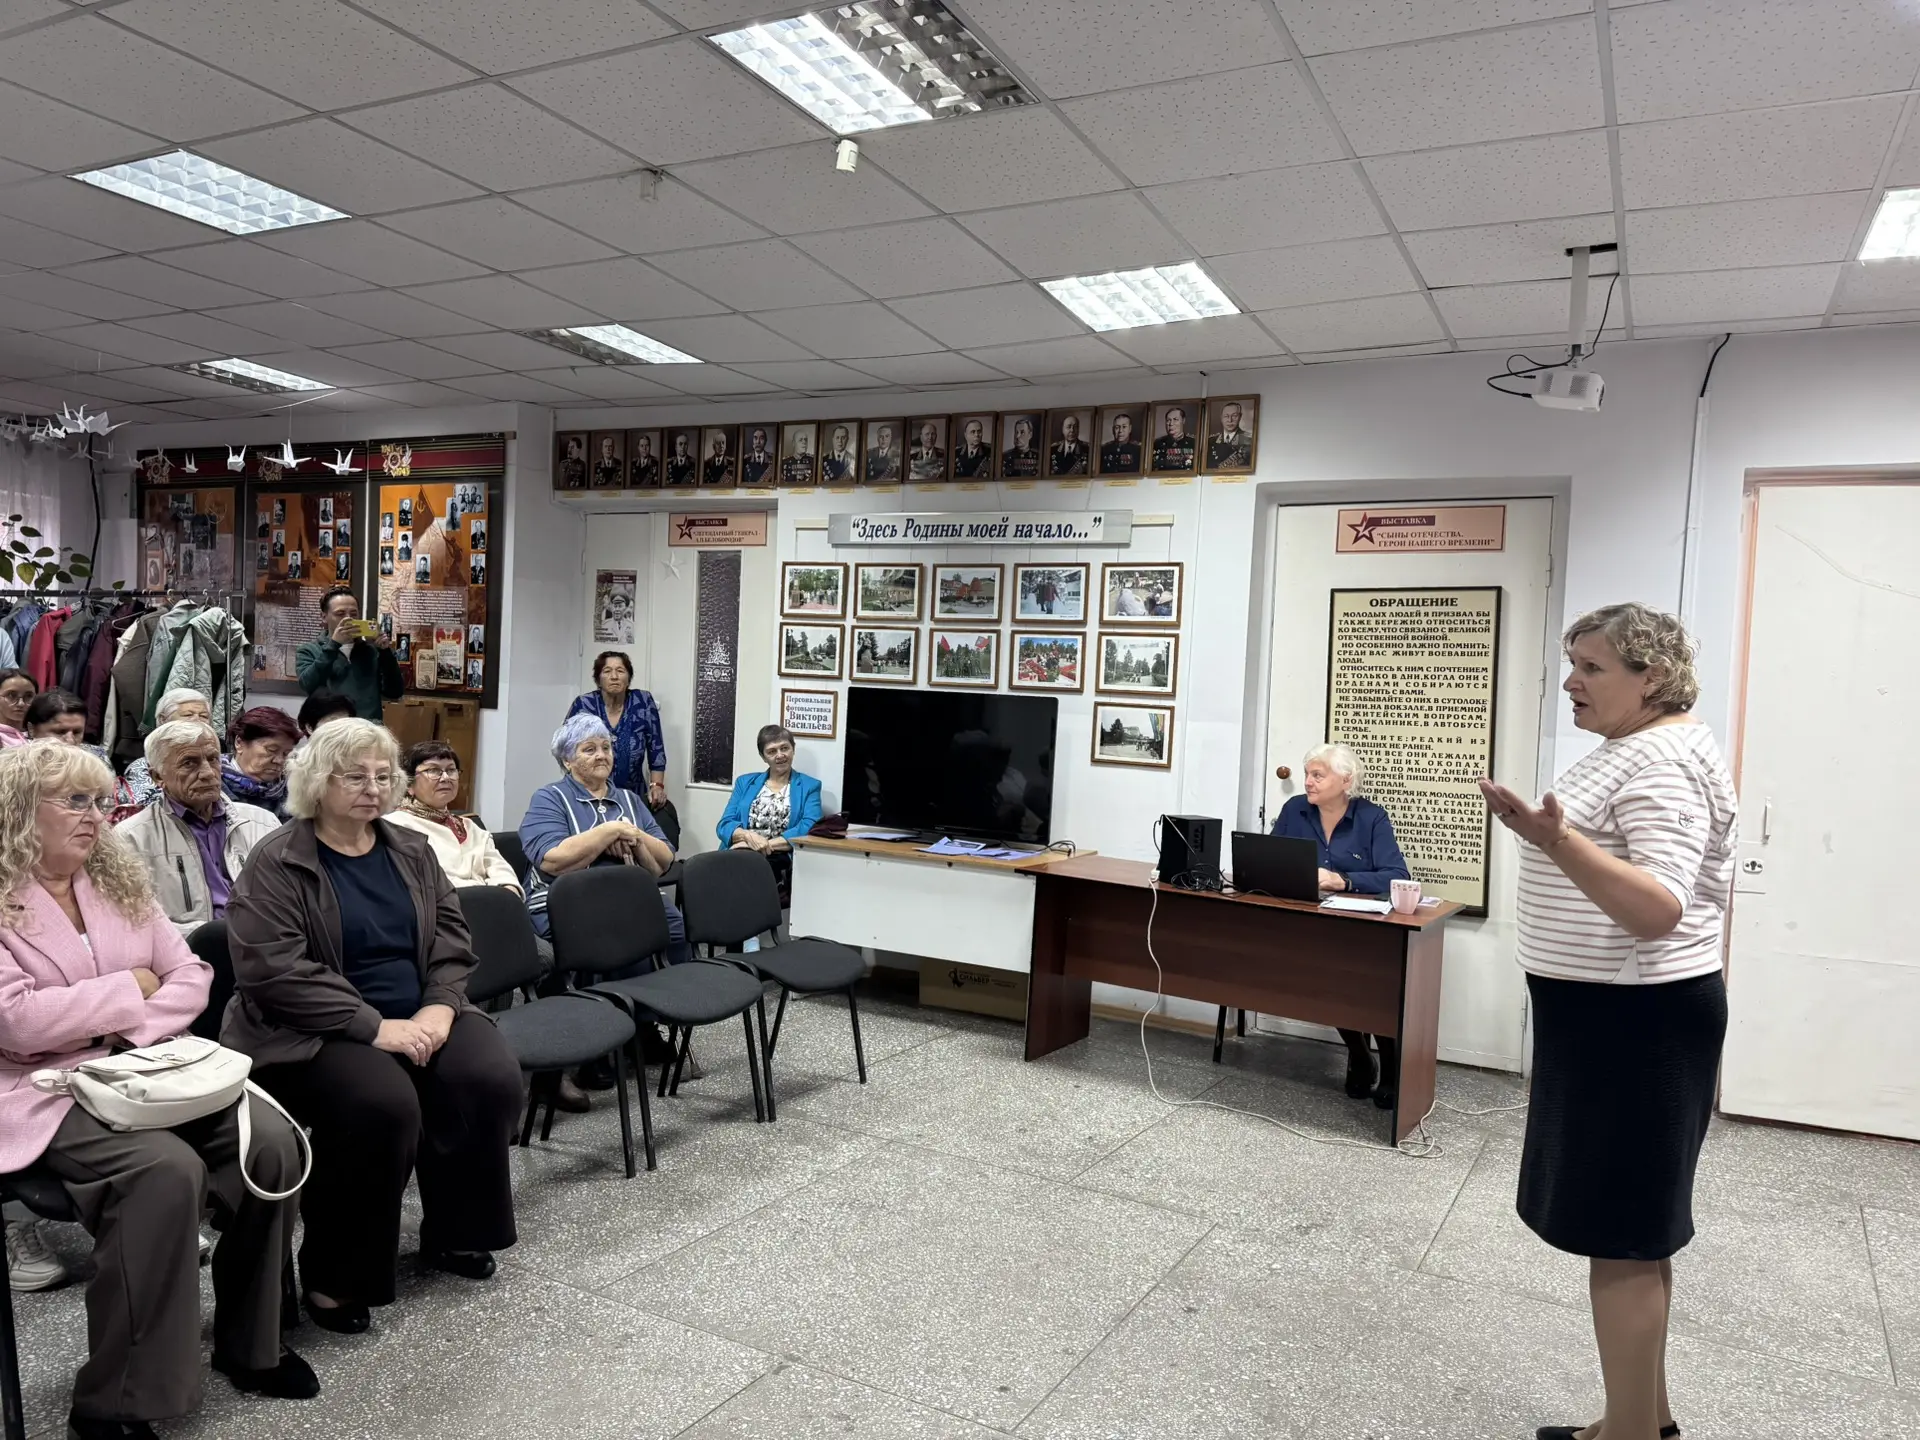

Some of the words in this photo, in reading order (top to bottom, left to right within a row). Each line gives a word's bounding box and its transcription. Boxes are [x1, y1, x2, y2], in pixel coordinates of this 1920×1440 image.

[902, 519, 964, 541] Родины
[966, 517, 1008, 538] моей
[1369, 598, 1458, 607] ОБРАЩЕНИЕ
[1448, 625, 1490, 633] ВЕЛИКОЙ
[1338, 633, 1409, 641] ОТЕЧЕСТВЕННОЙ
[1411, 633, 1450, 641] ВОЙНОЙ.
[786, 695, 832, 704] Персональная
[1352, 695, 1403, 703] ЗАБЫВАЙТЕ
[786, 704, 831, 713] фотовыставка
[1436, 704, 1487, 713] ПРИЕМНОЙ
[790, 711, 828, 723] Виктора
[1353, 710, 1419, 719] ЖИТЕЙСКИМ
[785, 719, 832, 730] Васильева
[1428, 760, 1485, 769] ОКОПАХ.
[1407, 767, 1438, 775] МНОГУ
[1442, 768, 1468, 776] ДНЕЙ
[1382, 796, 1422, 804] СОЛДАТ
[1444, 800, 1484, 808] СТАНЕТ
[1431, 807, 1483, 816] ЗАКВАСКА
[1432, 823, 1482, 832] ОСКОРБЛЯЯ
[1394, 828, 1447, 837] НОСИТЕСЬ
[1452, 840, 1481, 848] ОЧЕНЬ
[1460, 848, 1482, 856] ОНИ
[1412, 872, 1454, 880] СОВЕТСКОГО
